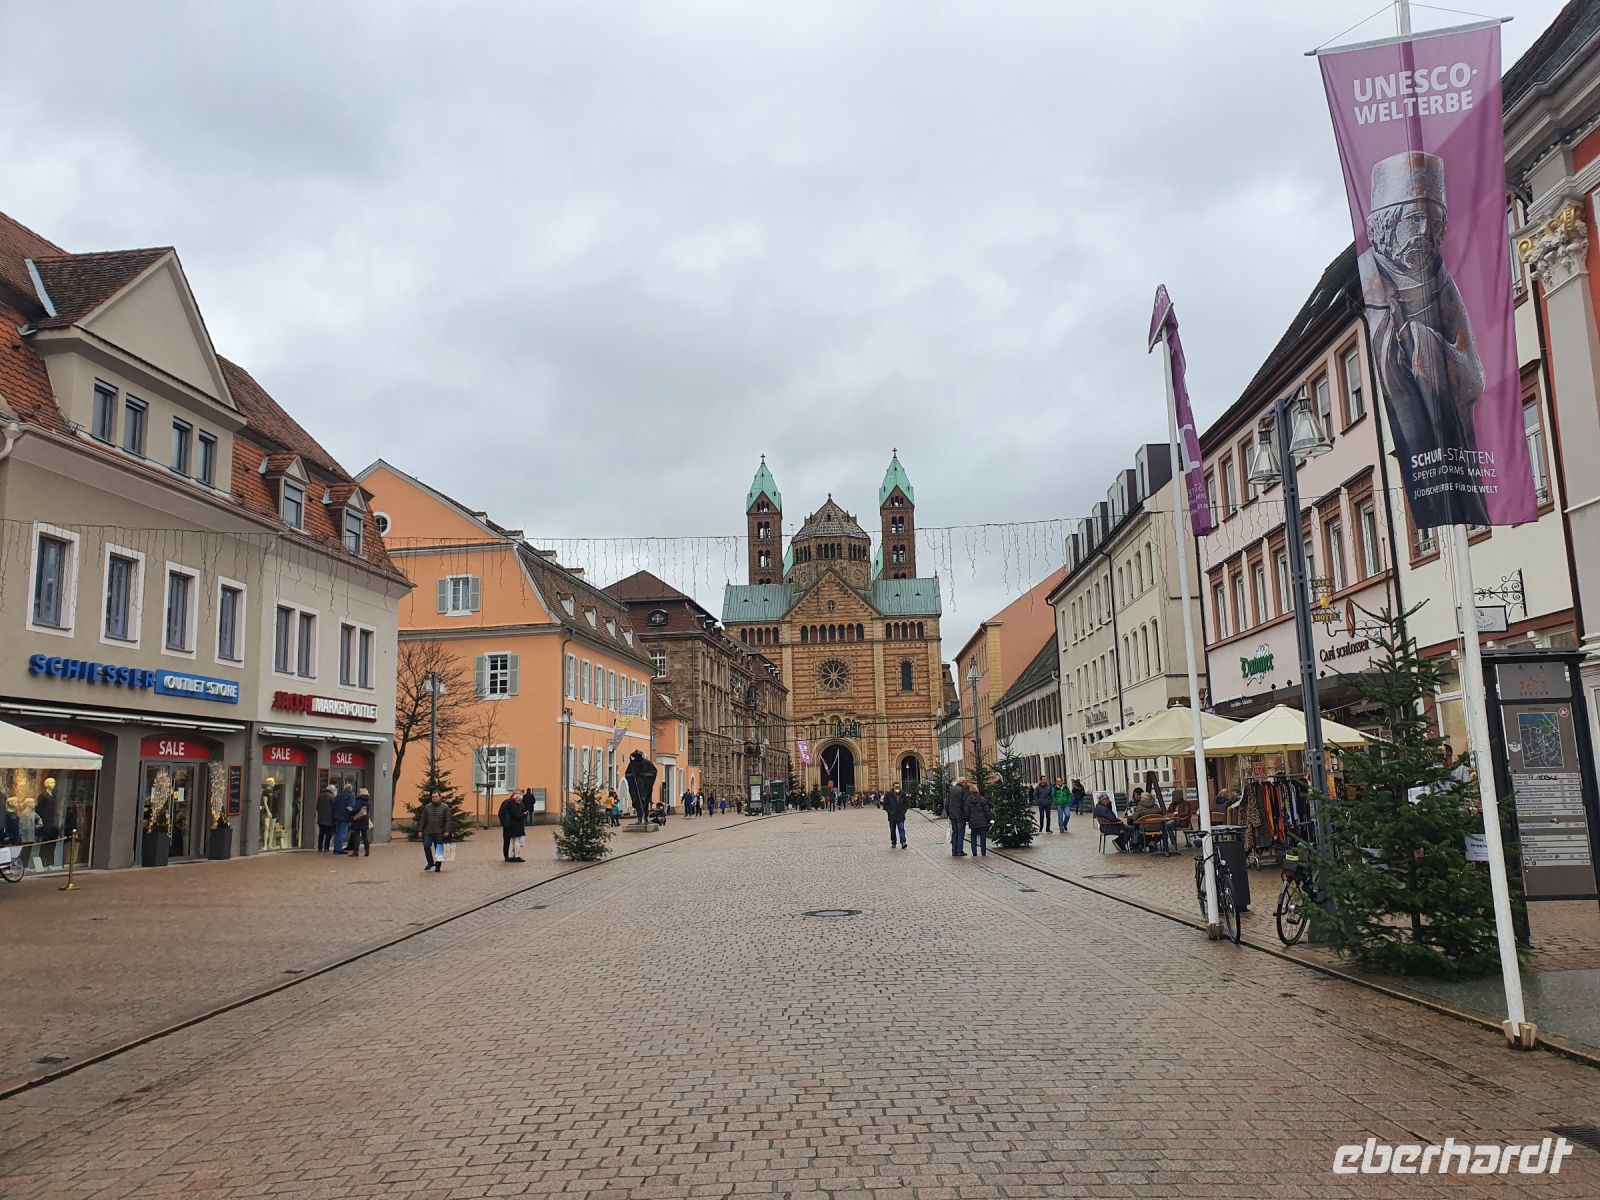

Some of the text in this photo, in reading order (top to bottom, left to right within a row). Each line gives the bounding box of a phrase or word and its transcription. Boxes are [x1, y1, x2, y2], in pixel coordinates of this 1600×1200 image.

[1353, 62, 1478, 102] UNESCO-
[1353, 89, 1473, 125] WELTERBE
[1412, 468, 1437, 482] SPEYER
[1467, 467, 1497, 478] MAINZ
[1467, 484, 1479, 493] DIE
[1478, 485, 1499, 494] WELT
[28, 653, 238, 698] SCHIESSER OUTLET STORE
[159, 740, 185, 756] SALE
[271, 747, 291, 760] SALE
[336, 752, 353, 764] SALE
